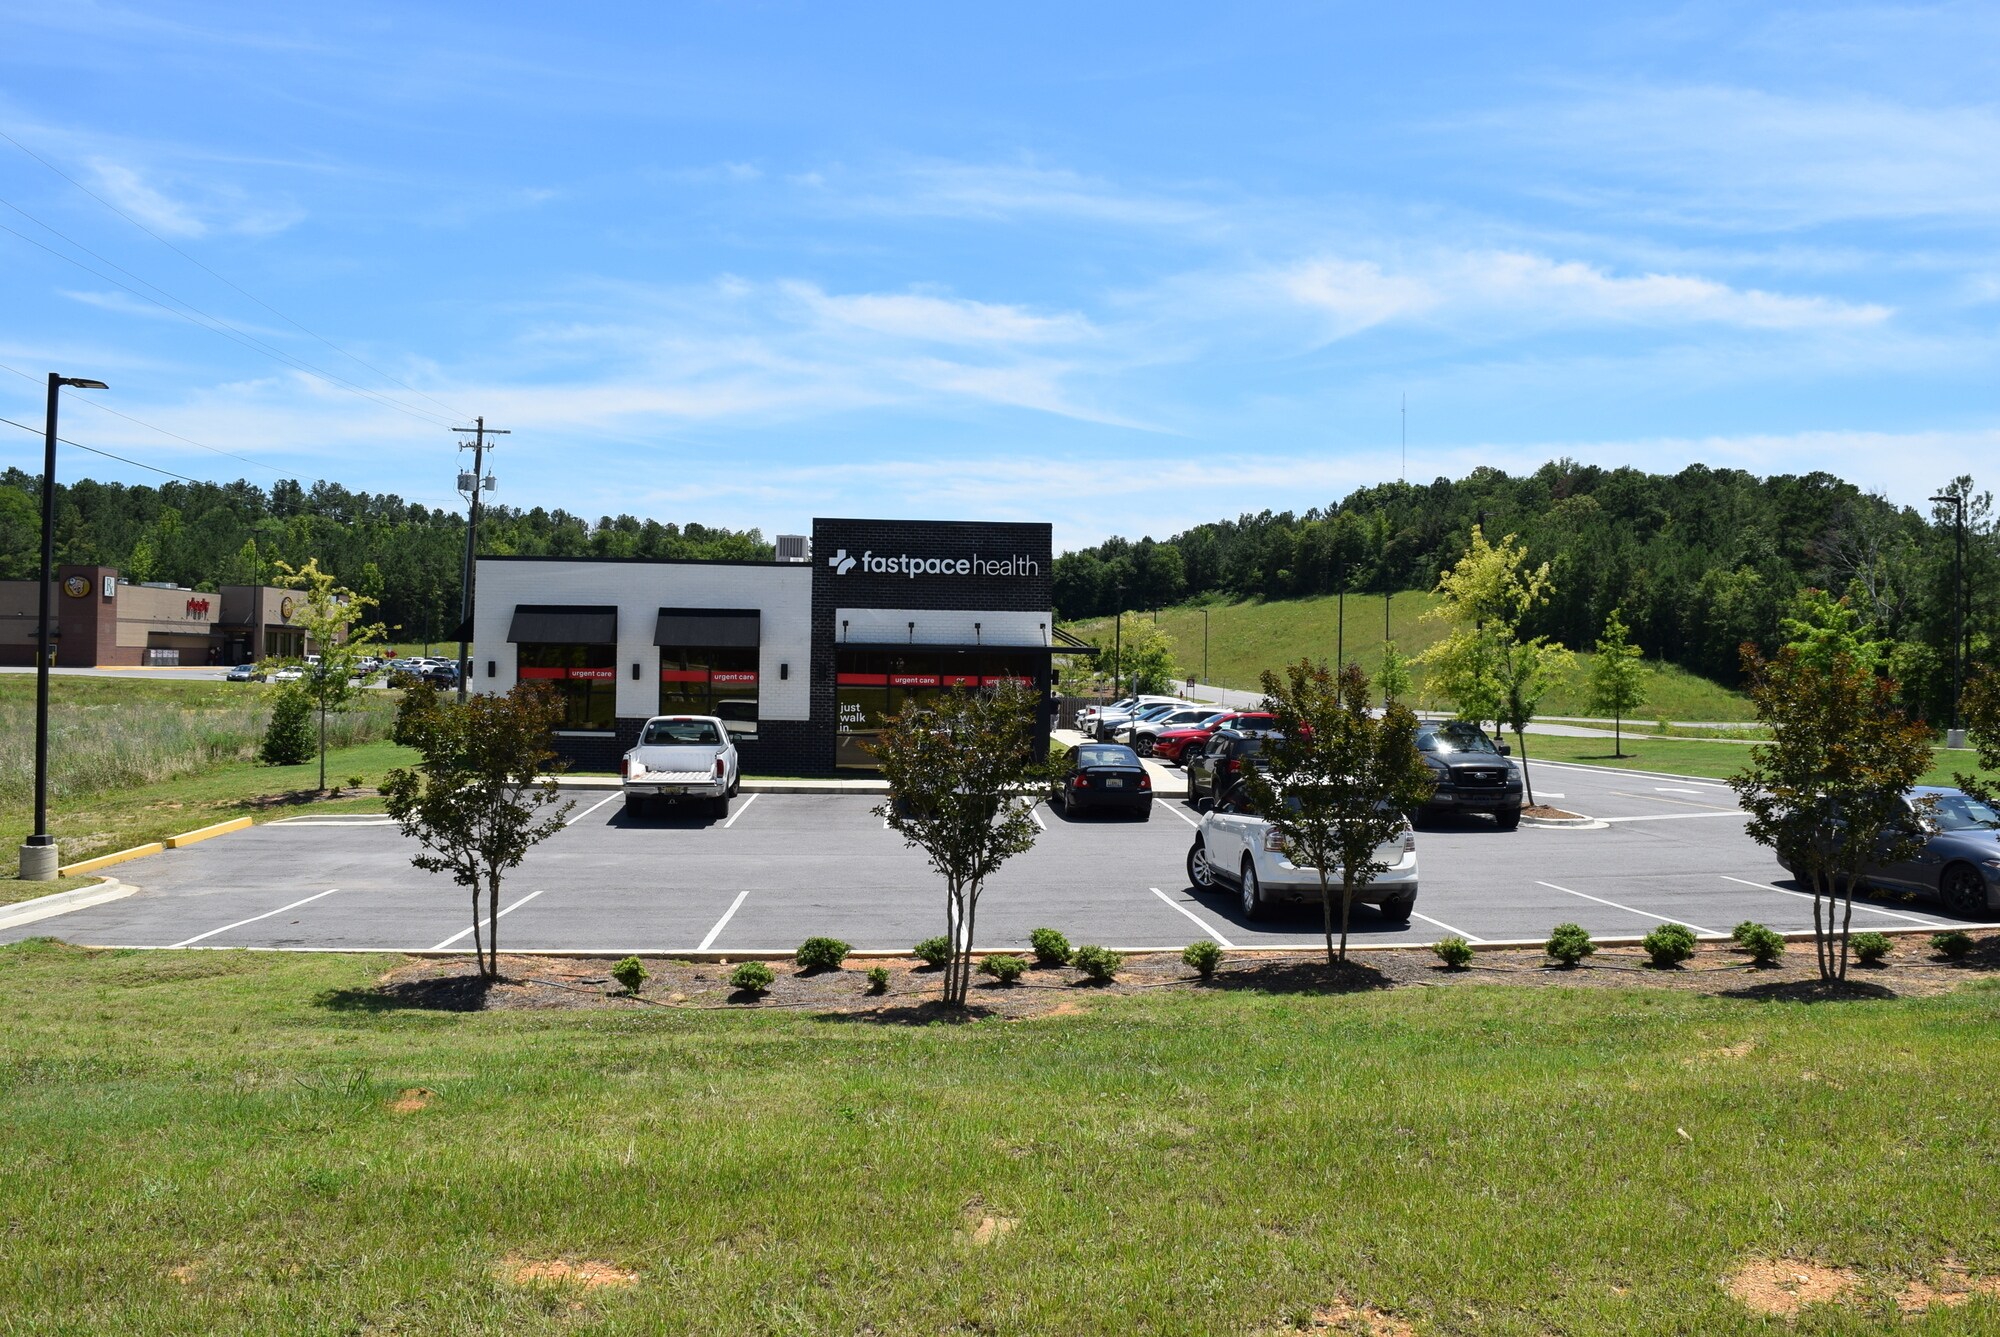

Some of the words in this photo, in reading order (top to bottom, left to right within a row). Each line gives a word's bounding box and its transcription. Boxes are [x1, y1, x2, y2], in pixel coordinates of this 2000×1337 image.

[840, 702, 861, 714] just
[840, 712, 866, 722] walk
[839, 722, 853, 732] in.
